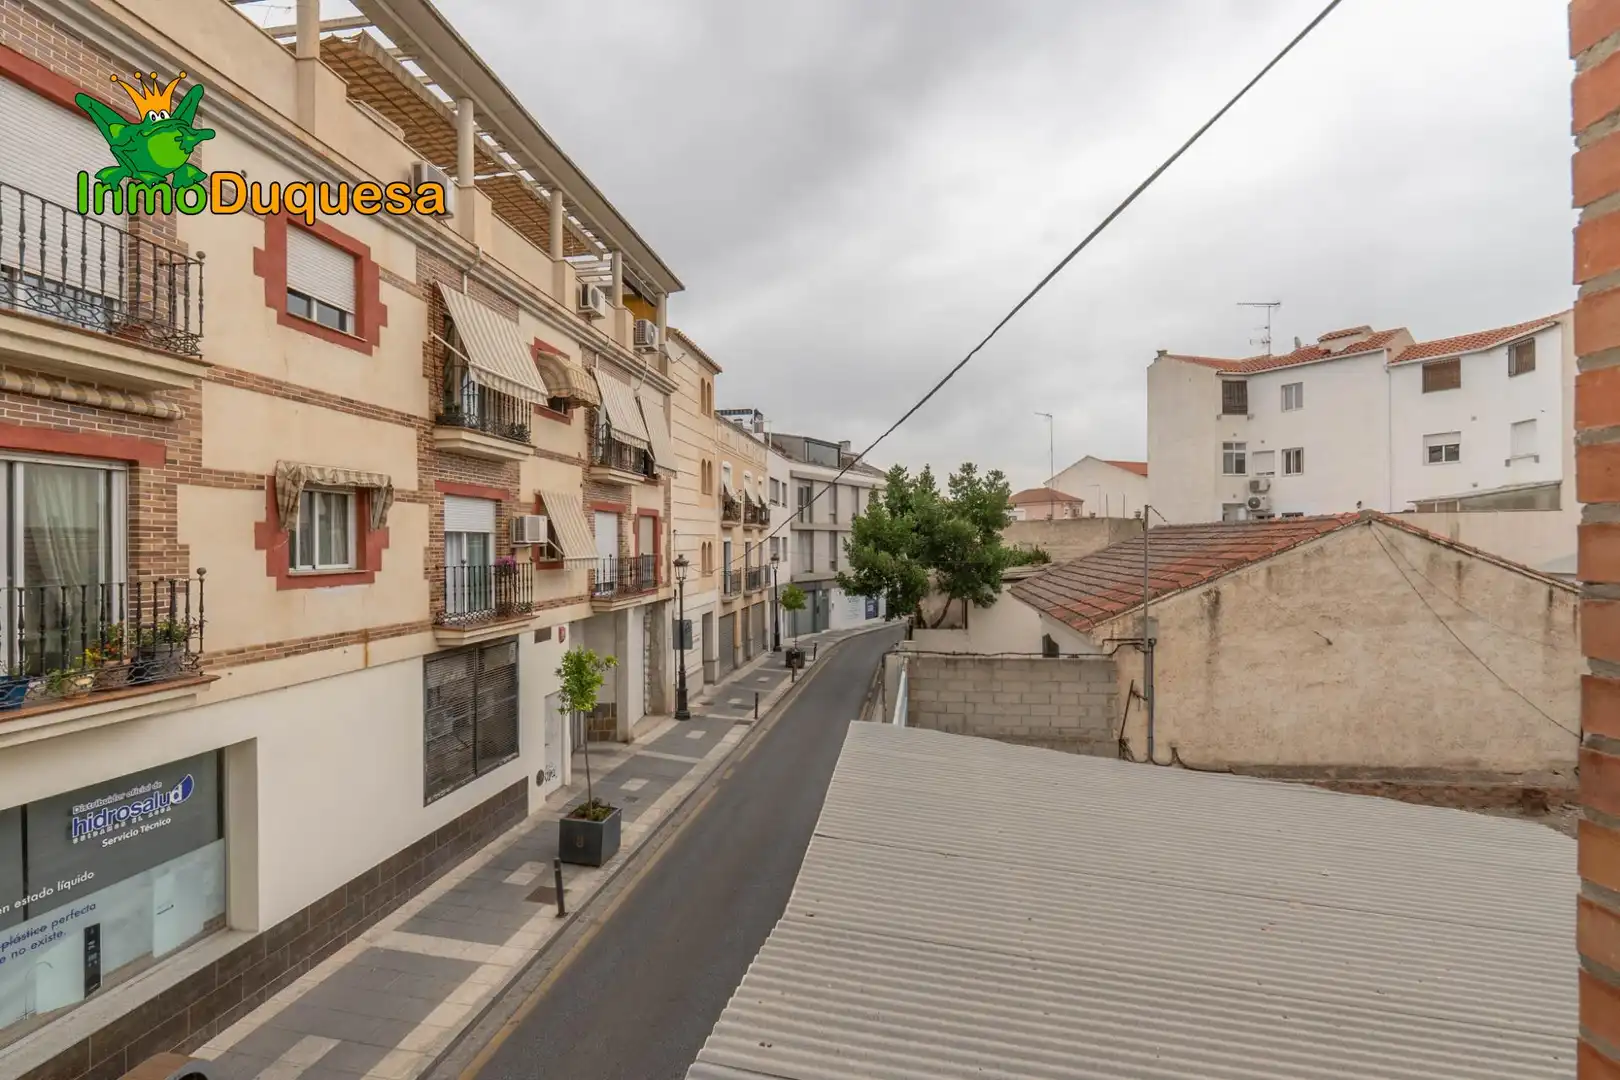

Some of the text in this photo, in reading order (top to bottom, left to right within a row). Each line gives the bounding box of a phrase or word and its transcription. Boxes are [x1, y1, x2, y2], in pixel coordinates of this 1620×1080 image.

[151, 780, 163, 790] de
[72, 778, 190, 838] hidrosalud
[101, 817, 171, 848] Servicio Técnico
[14, 886, 54, 908] estado
[57, 870, 95, 892] líquido
[1, 903, 96, 952] plástico perfecta
[11, 948, 26, 960] no
[31, 930, 67, 950] existe.
